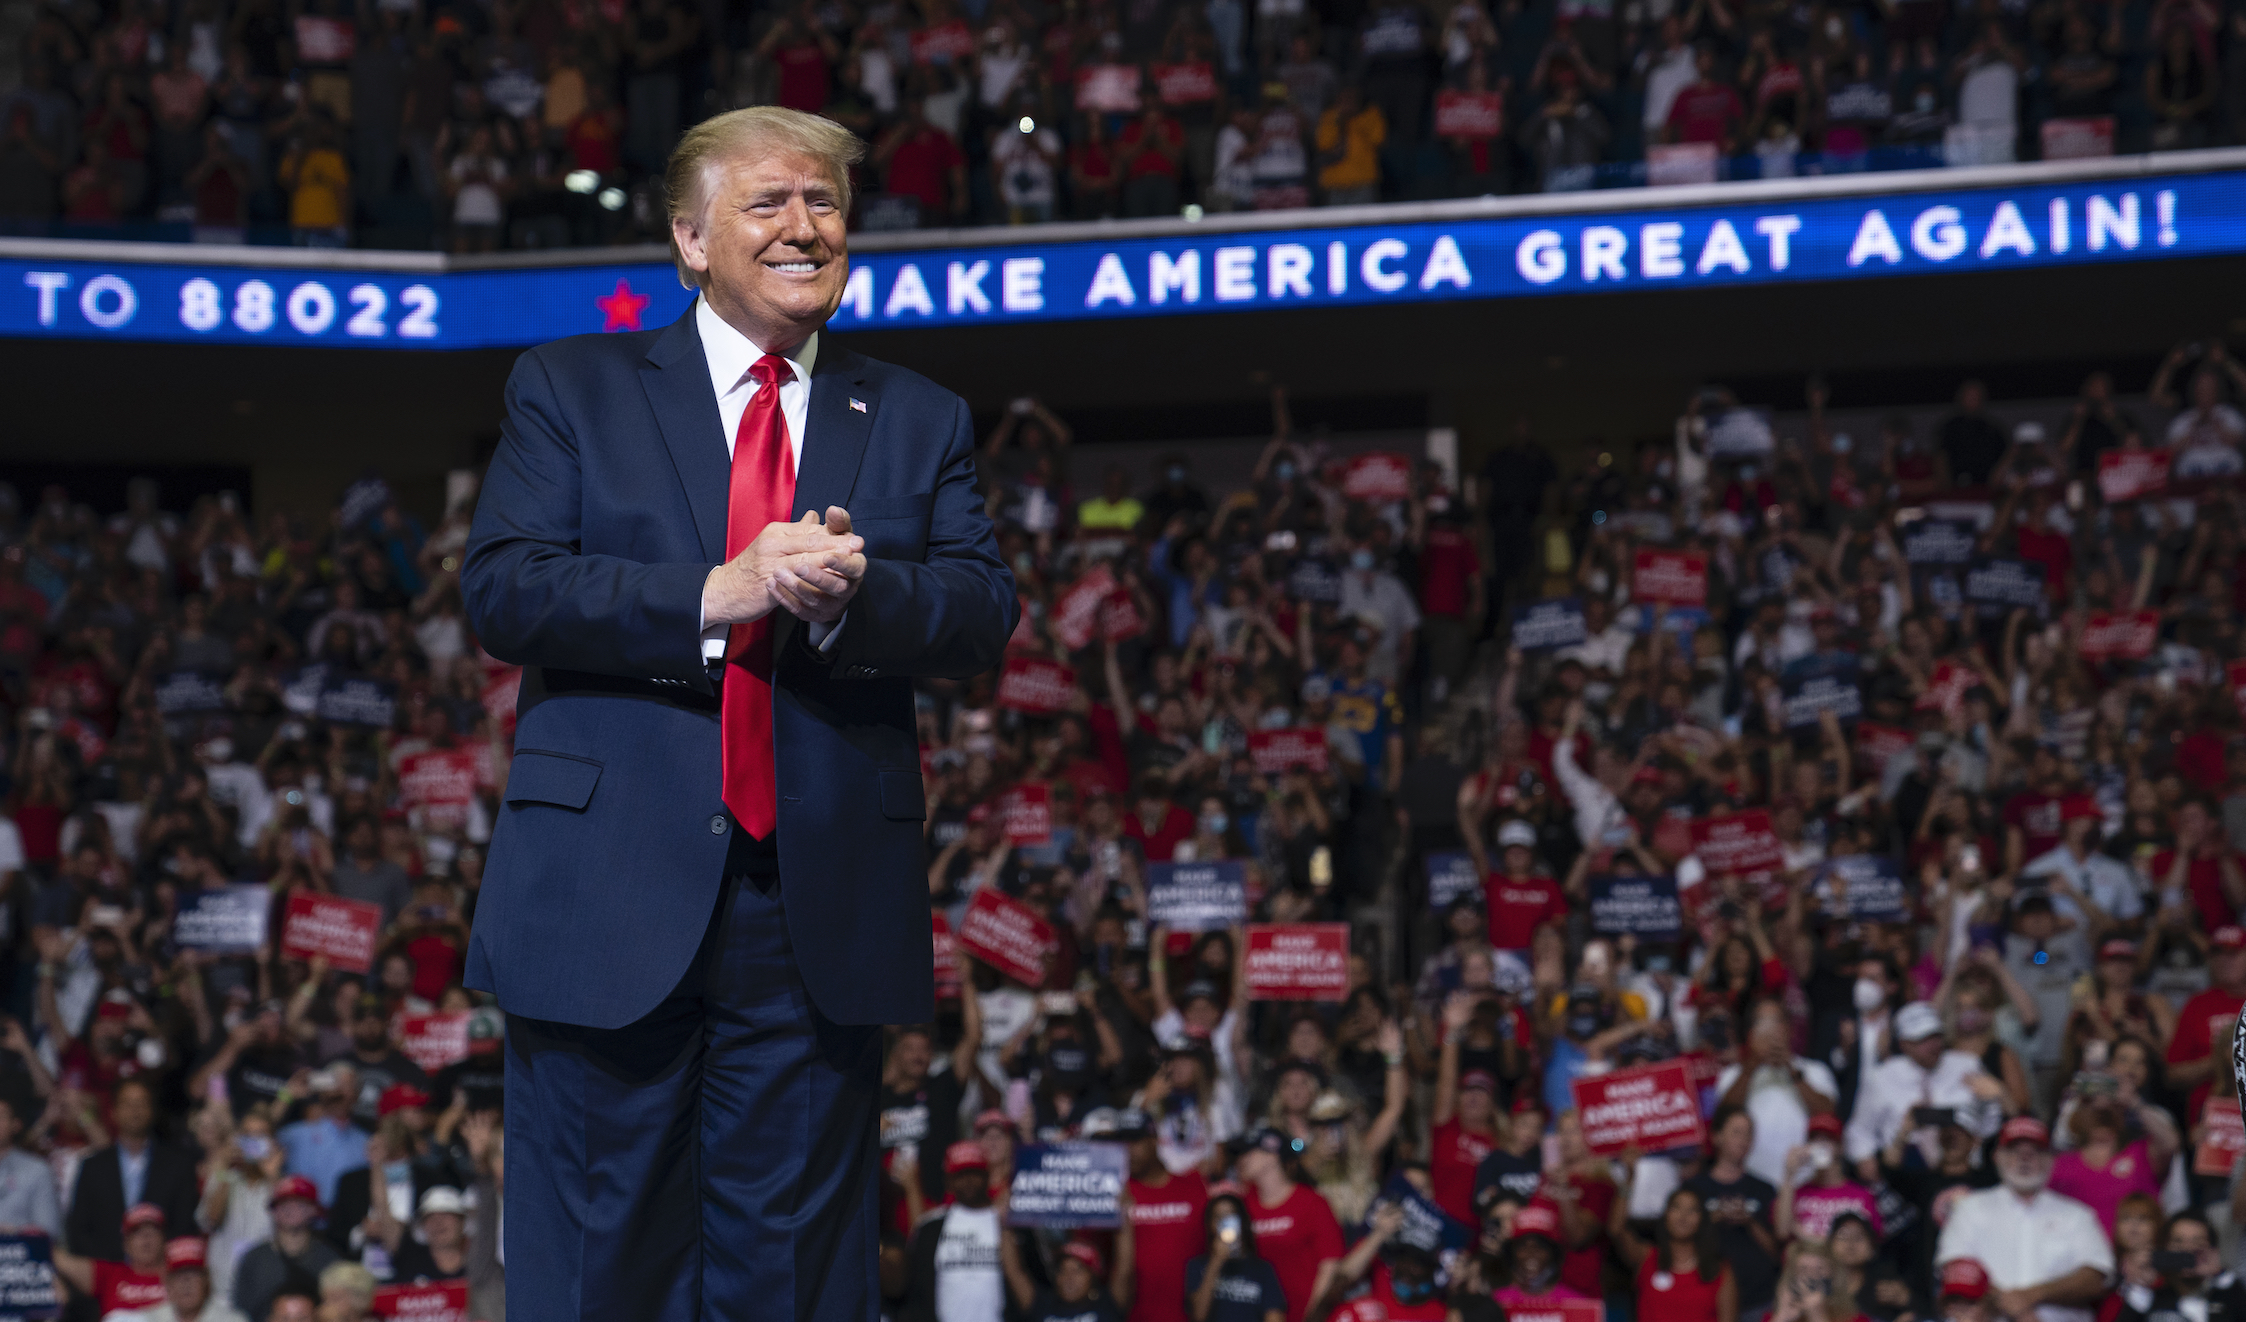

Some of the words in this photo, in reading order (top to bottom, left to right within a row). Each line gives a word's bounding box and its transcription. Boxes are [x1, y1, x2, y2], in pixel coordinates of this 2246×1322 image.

[830, 259, 1044, 319] MAKE
[1086, 234, 1473, 308] AMERICA
[1516, 214, 1802, 284] GREAT
[1847, 189, 2181, 268] AGAIN!
[24, 271, 138, 328] TO
[179, 276, 440, 339] 88022
[1584, 1091, 1692, 1124] AMERICA
[1012, 1171, 1119, 1195] AMERICA
